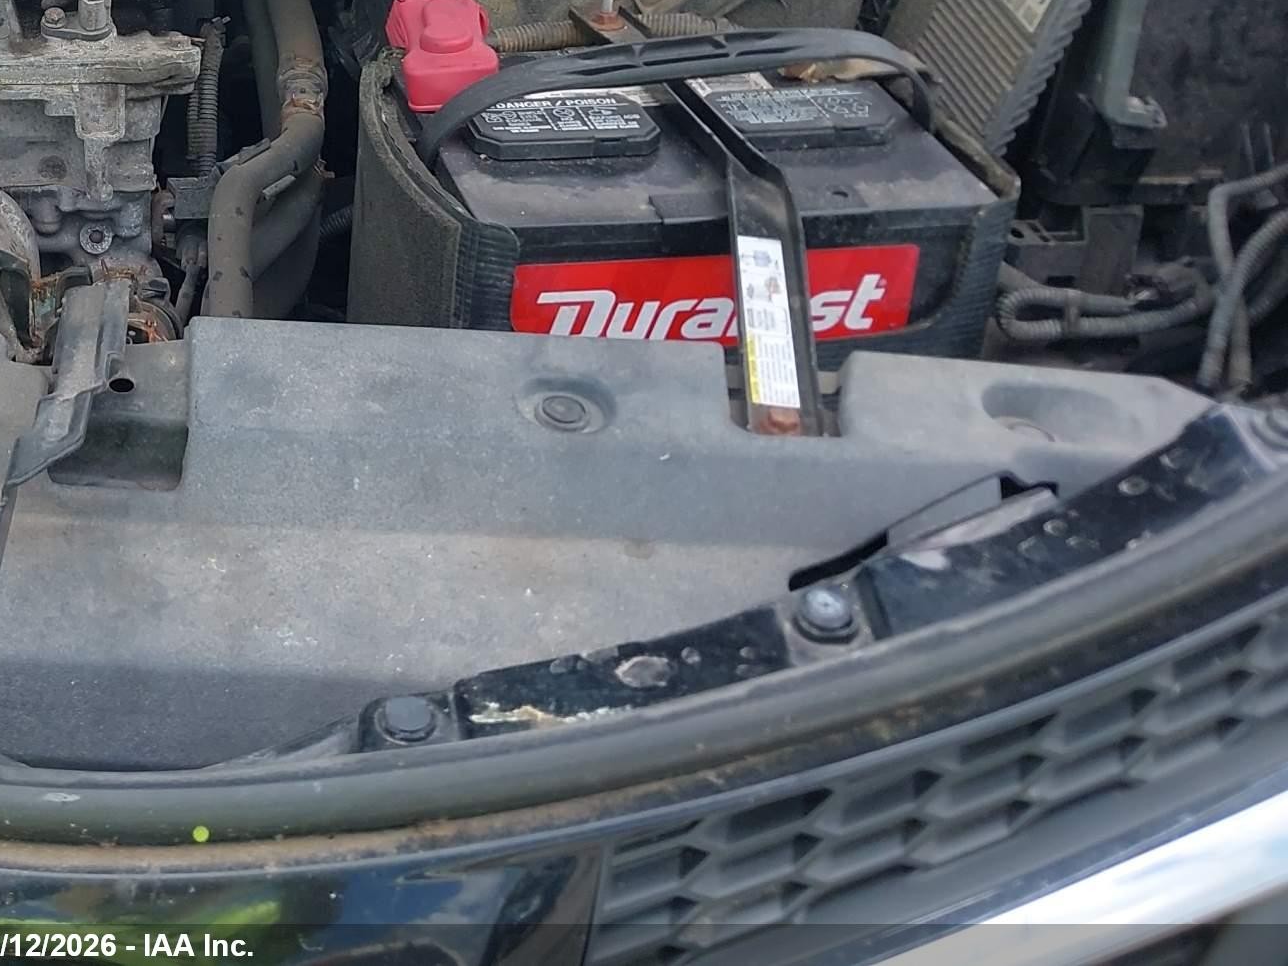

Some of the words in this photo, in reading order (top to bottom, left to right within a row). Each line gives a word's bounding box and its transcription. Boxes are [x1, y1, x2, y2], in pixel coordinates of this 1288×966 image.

[496, 100, 552, 109] DANGER
[565, 97, 617, 106] POISON
[536, 272, 886, 341] Durast
